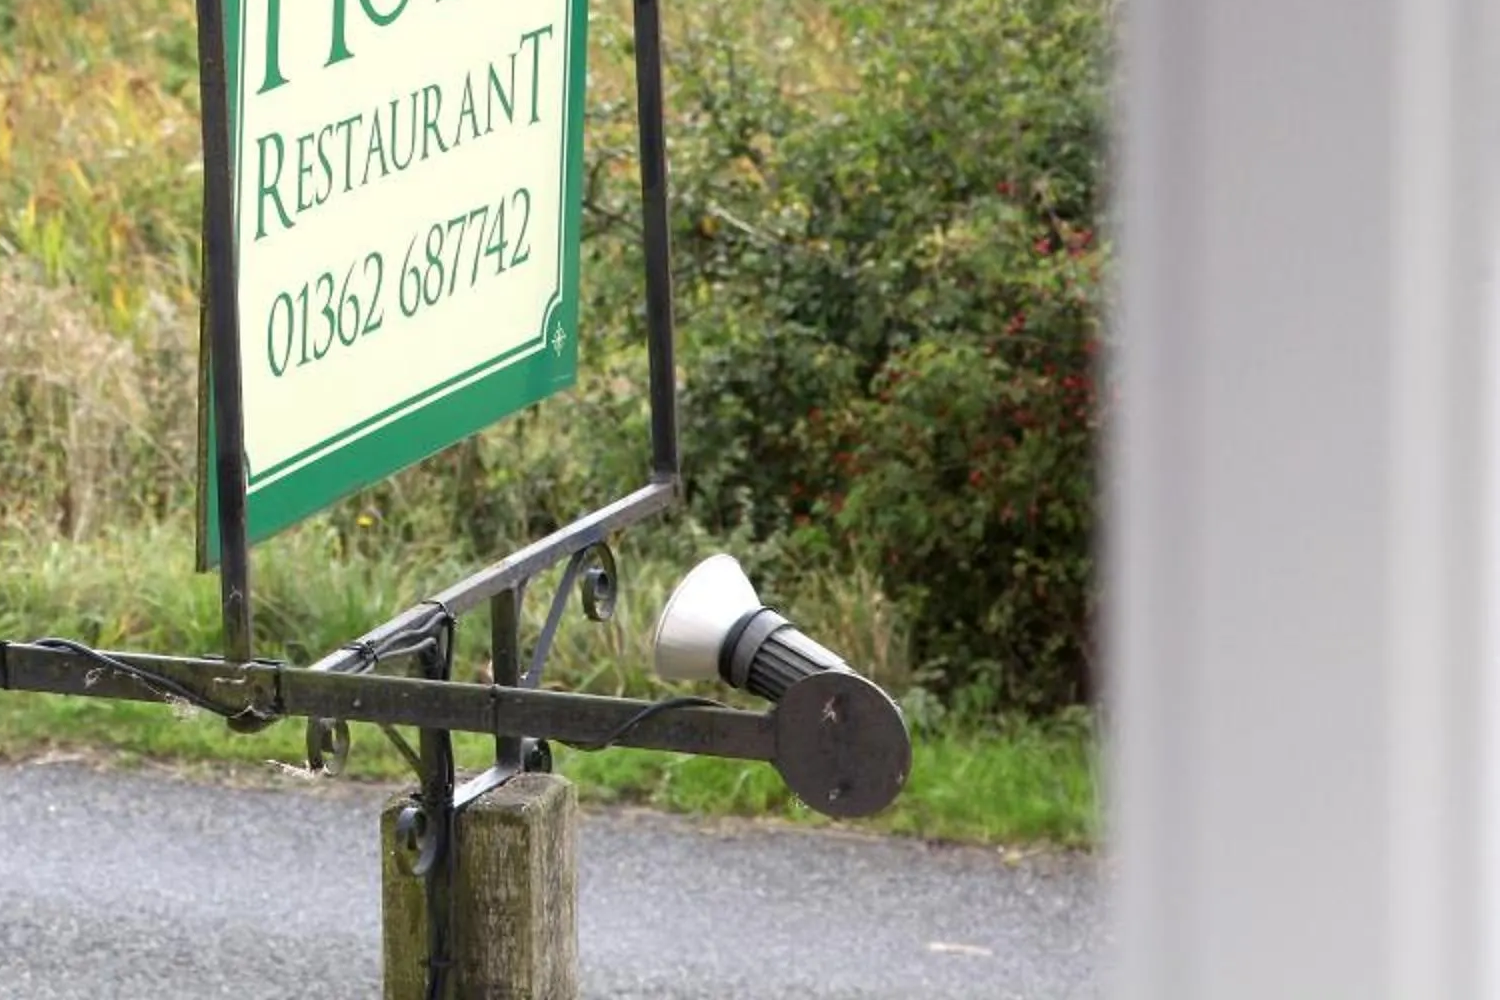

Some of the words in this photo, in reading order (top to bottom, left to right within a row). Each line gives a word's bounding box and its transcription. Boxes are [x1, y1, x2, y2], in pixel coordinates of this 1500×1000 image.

[254, 24, 553, 241] RESTAURANT
[267, 251, 384, 377] 01362
[399, 187, 531, 317] 687742
